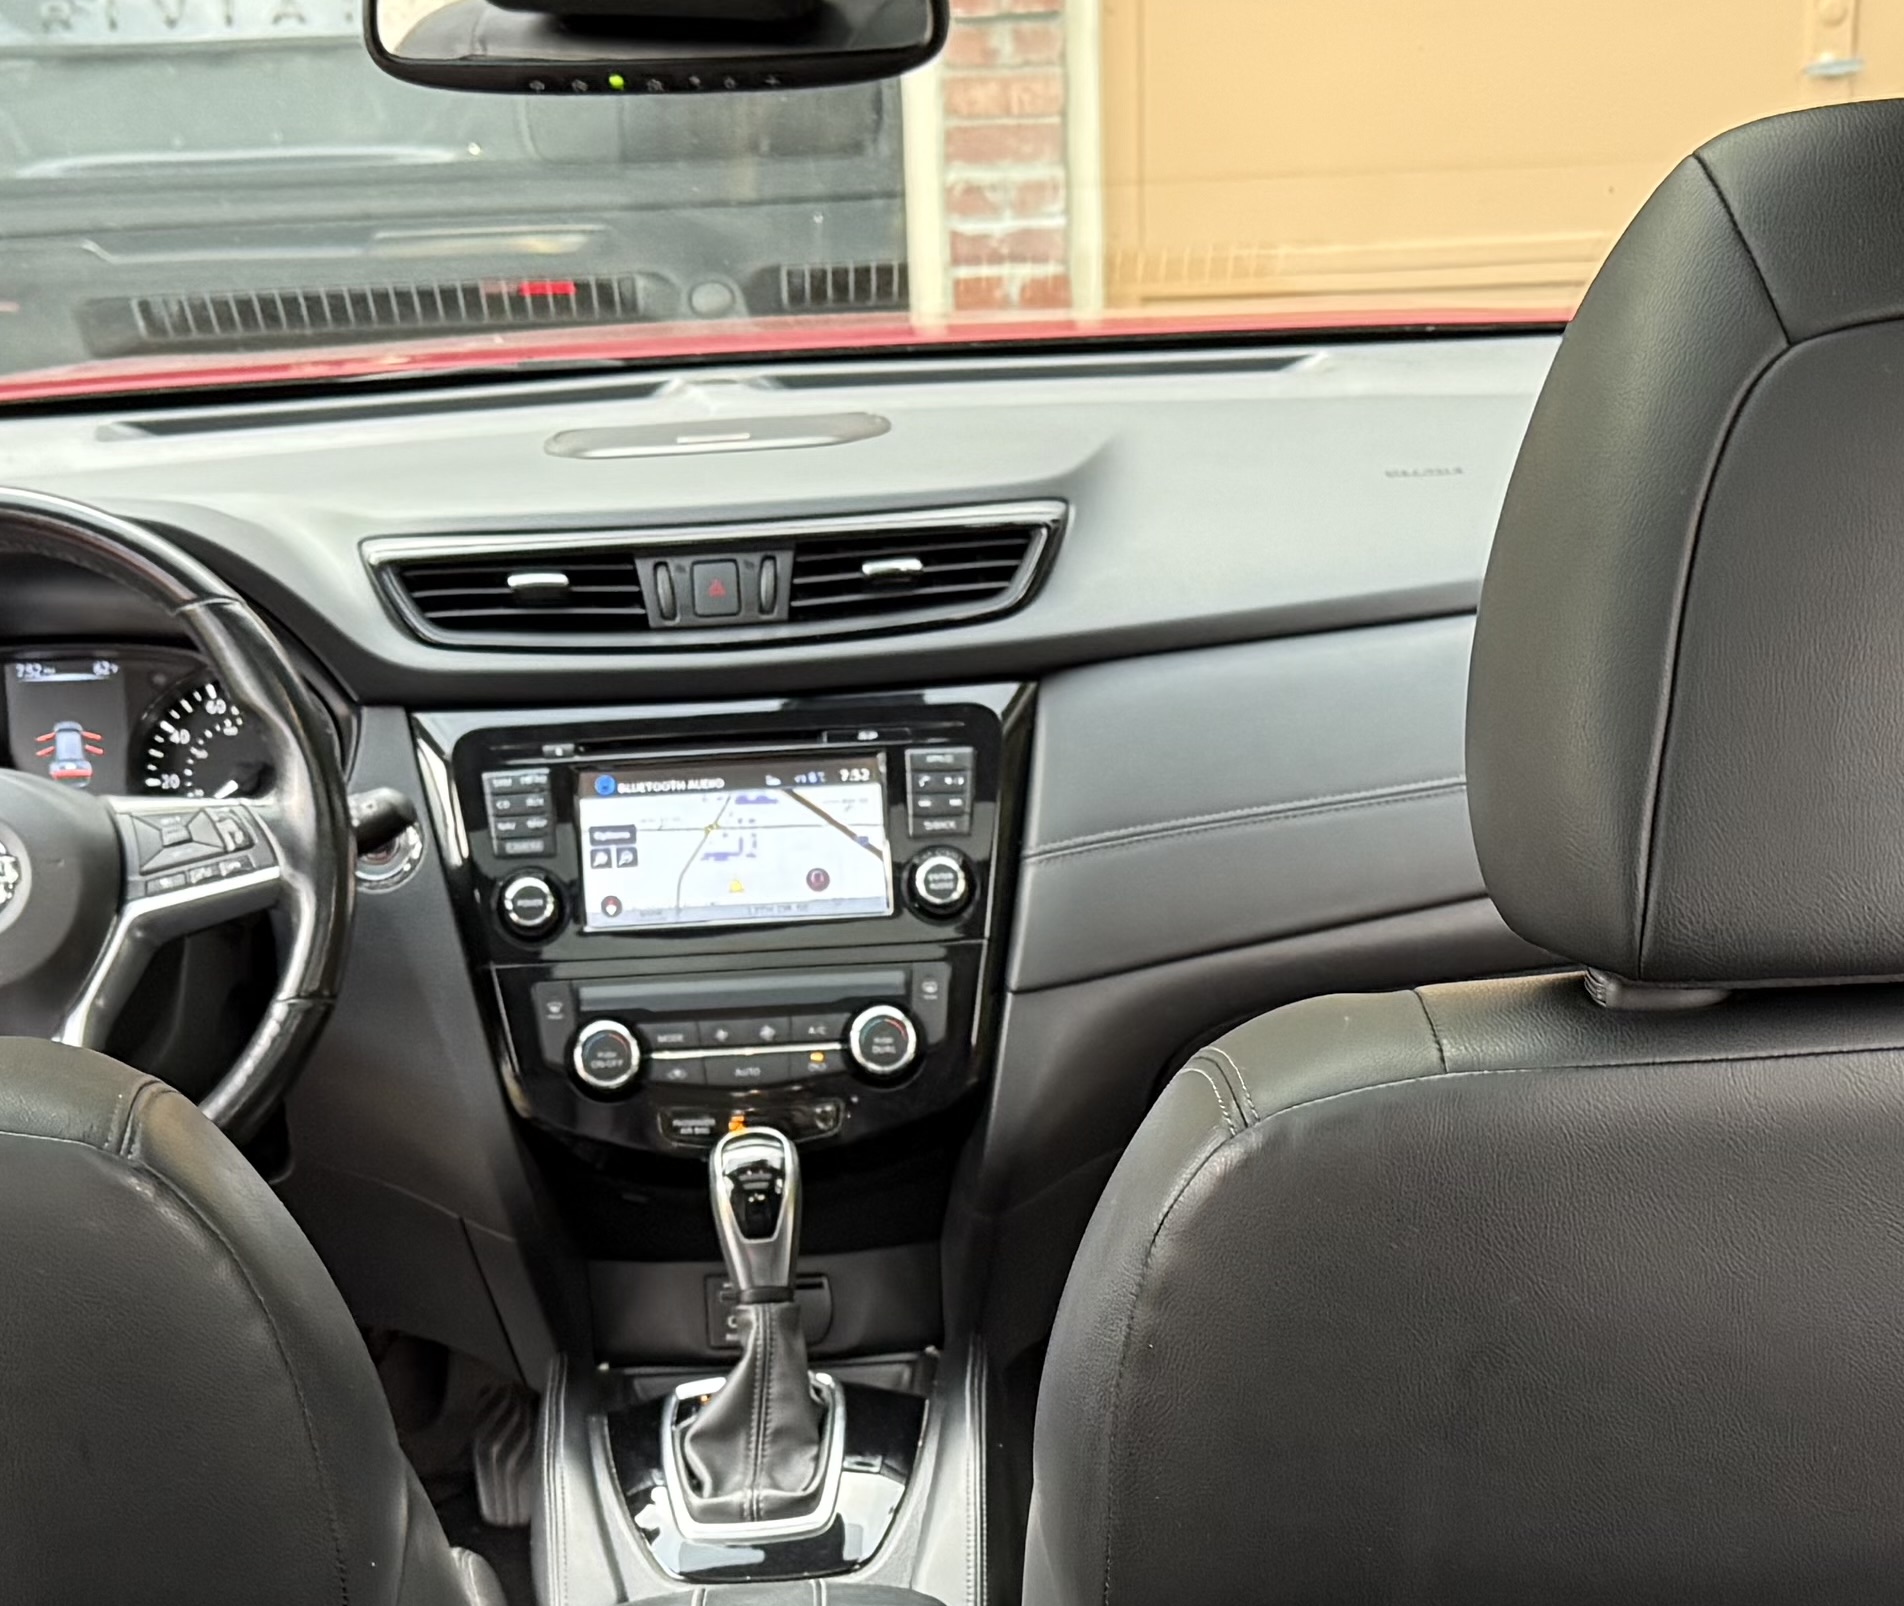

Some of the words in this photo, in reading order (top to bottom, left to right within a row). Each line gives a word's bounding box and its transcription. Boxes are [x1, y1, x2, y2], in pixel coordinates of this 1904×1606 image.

[205, 698, 227, 715] 60
[169, 728, 191, 745] 40
[161, 773, 180, 790] 20
[617, 779, 687, 794] BLUETOOTH
